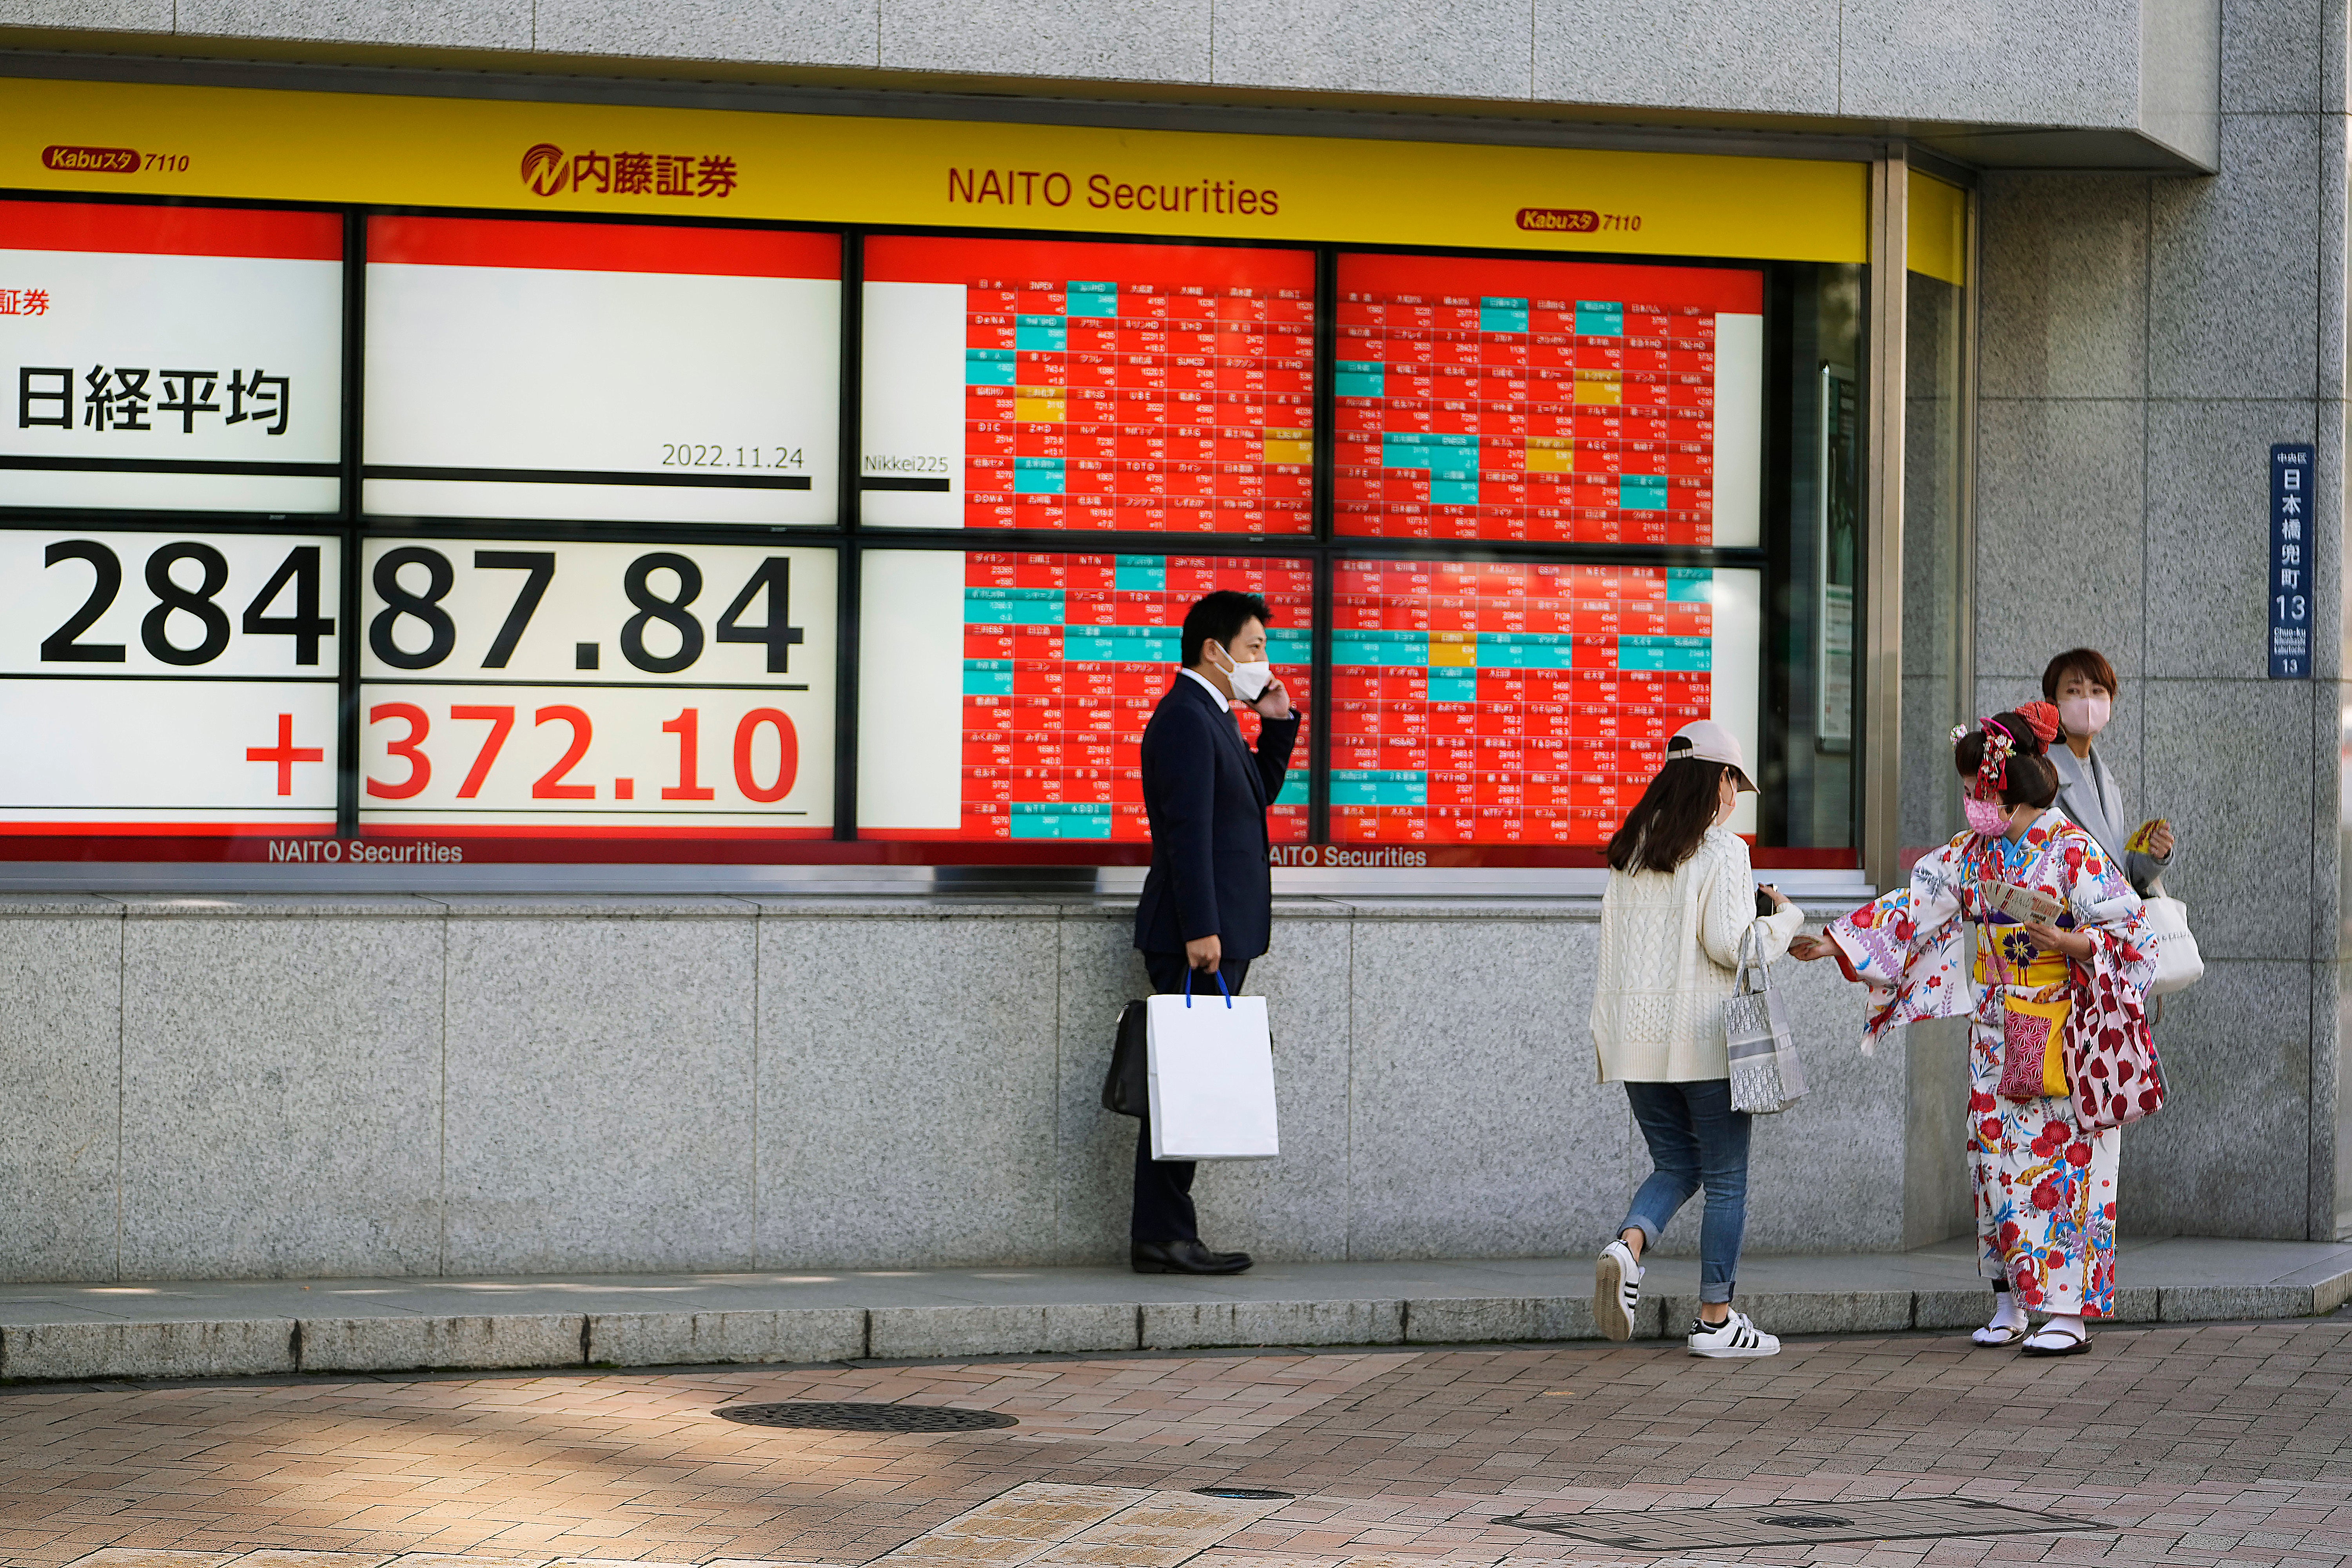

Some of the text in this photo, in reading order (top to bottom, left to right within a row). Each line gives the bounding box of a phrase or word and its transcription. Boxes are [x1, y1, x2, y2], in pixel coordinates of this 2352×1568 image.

[51, 149, 190, 172] Kabuスタ 7110
[573, 149, 738, 198] 内藤証券
[949, 167, 1279, 216] NAITO Securities
[1523, 210, 1642, 231] Kabuスタ 7110
[0, 289, 49, 316] 証券
[18, 364, 290, 436] 日経平均
[978, 422, 1001, 432] DIC
[662, 444, 804, 468] 2022.11.24
[865, 455, 949, 473] Nikkei225
[1126, 462, 1155, 471] TOTO
[2277, 452, 2307, 465] 中央区
[975, 494, 1004, 503] DOWA
[2281, 469, 2302, 590] 日本橋兜町
[2277, 594, 2306, 620] 13
[2283, 659, 2298, 673] 13
[269, 840, 463, 863] NAITO Securities
[1269, 845, 1427, 867] AITO Securities
